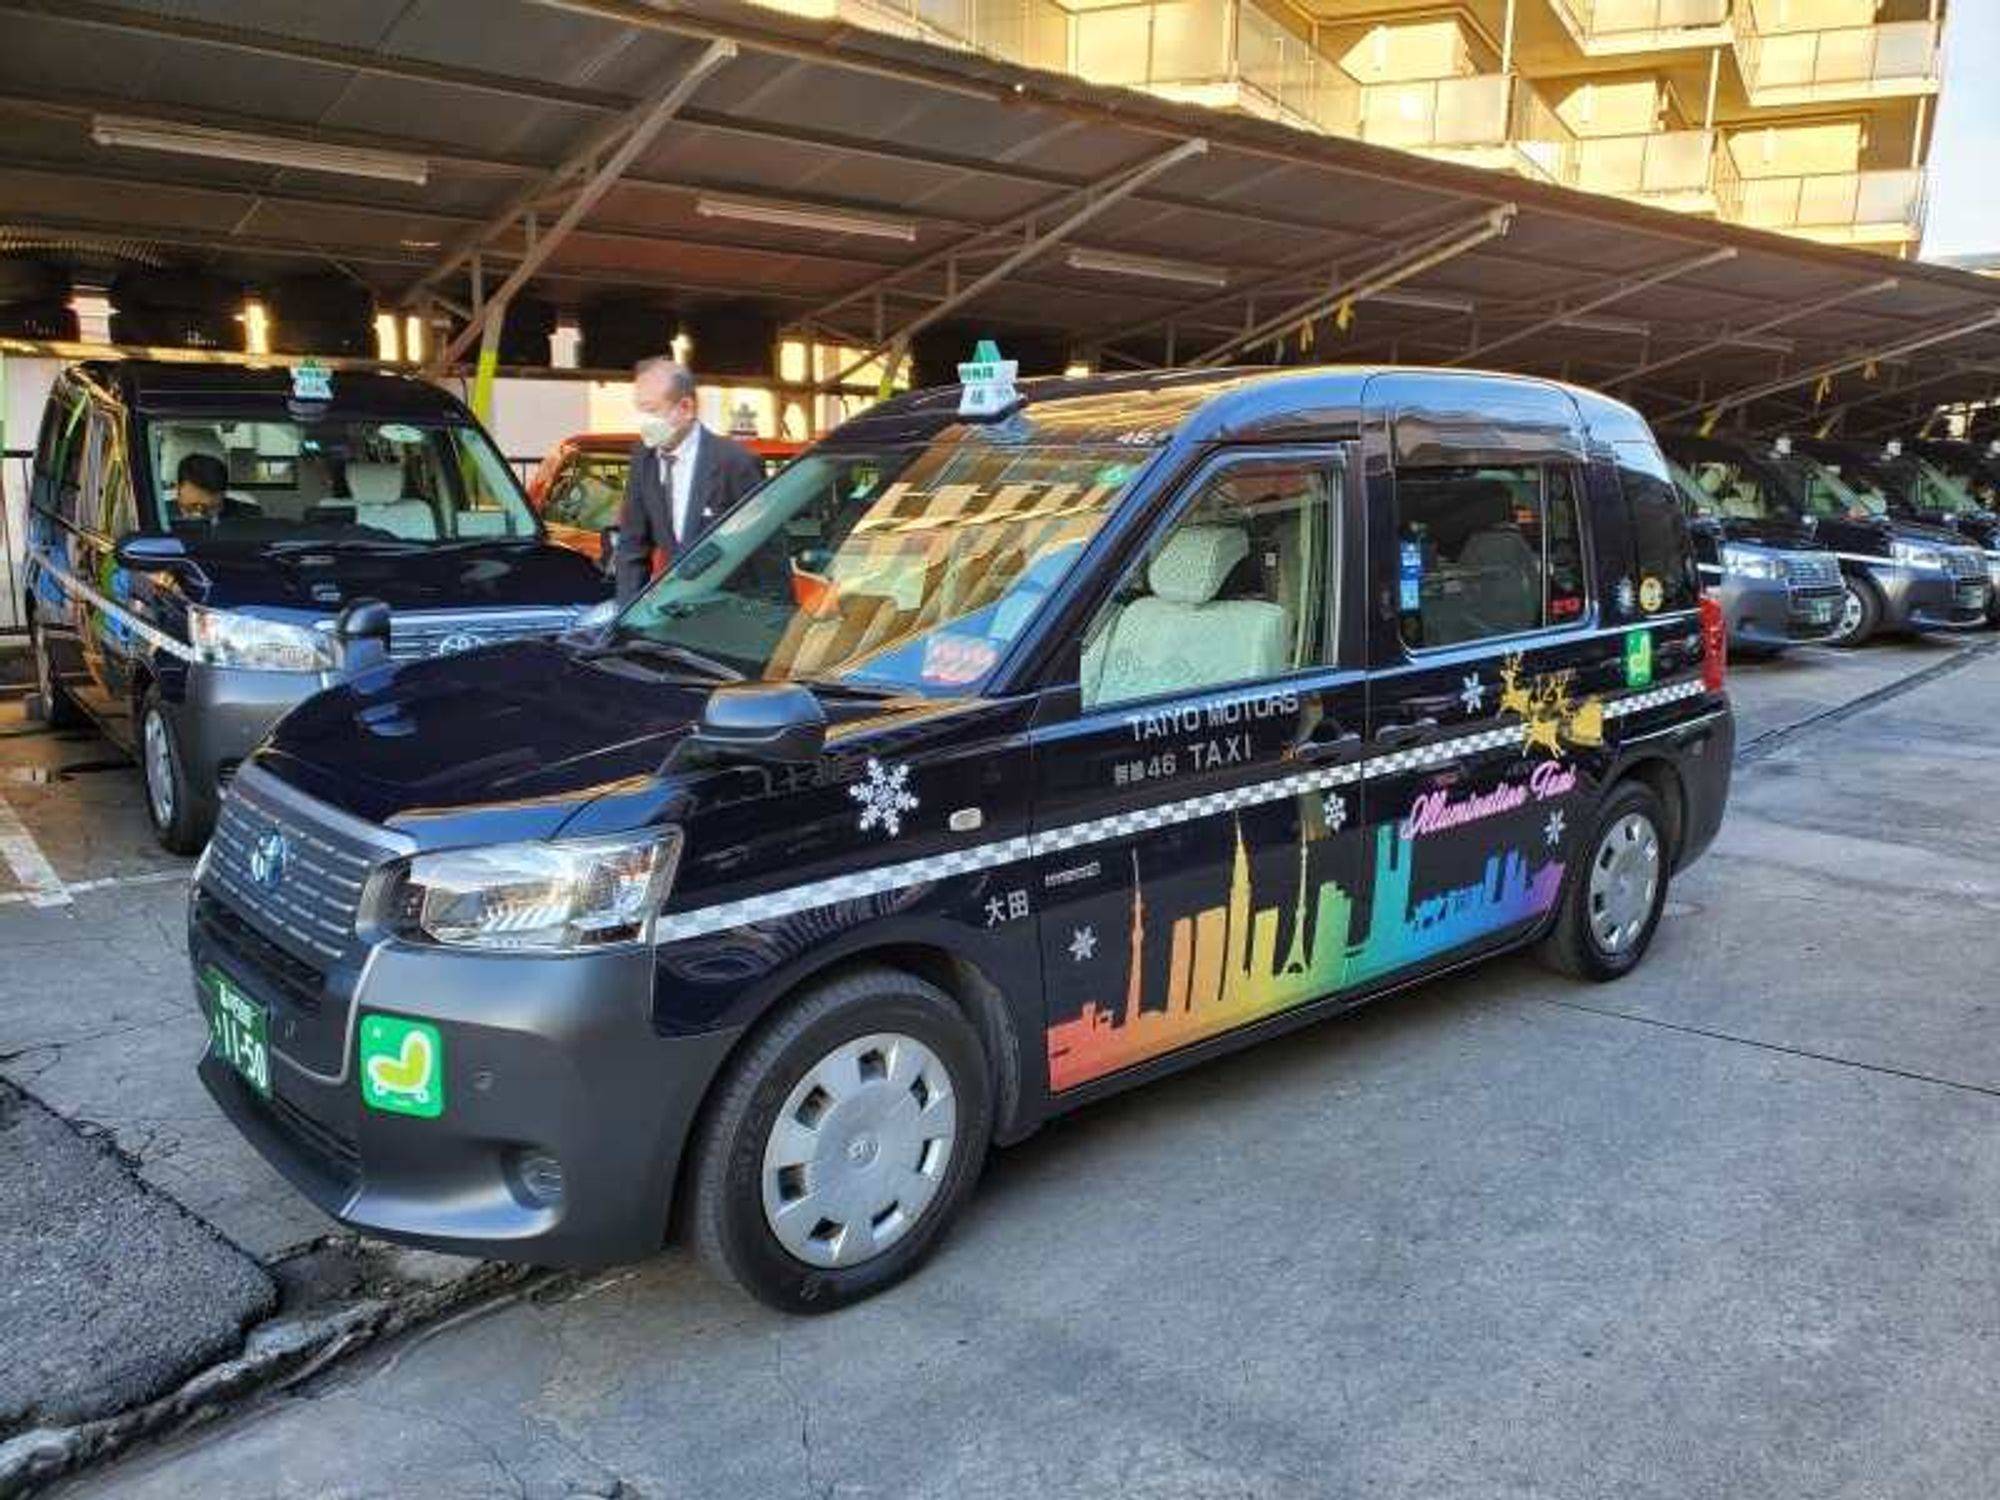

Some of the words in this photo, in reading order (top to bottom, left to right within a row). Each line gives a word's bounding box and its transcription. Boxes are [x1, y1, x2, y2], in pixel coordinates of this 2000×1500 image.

[1126, 705, 1200, 742] TAIYO
[1207, 690, 1299, 728] MOTORS
[1188, 729, 1252, 772] TAXI
[984, 889, 1029, 927] 大田
